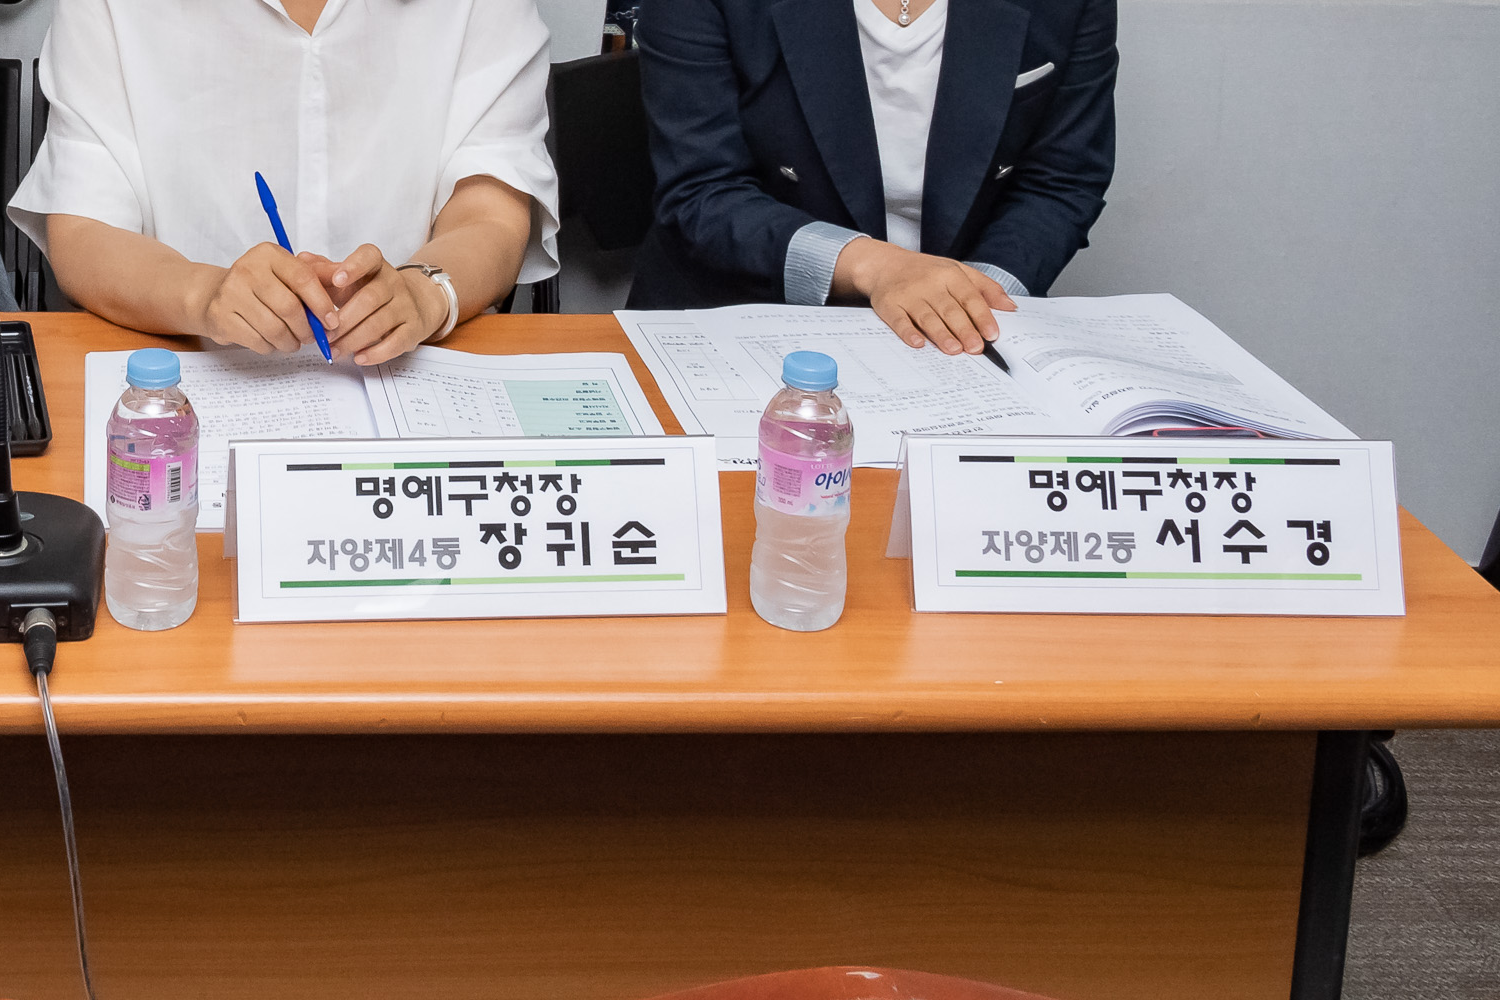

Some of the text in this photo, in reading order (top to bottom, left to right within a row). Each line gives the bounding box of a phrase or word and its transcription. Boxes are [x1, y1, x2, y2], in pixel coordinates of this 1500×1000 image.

[356, 472, 582, 519] 명예구청장
[1029, 469, 1257, 513] 명예구청장
[307, 537, 461, 573] 자양제4동
[981, 529, 1137, 564] 자양제2동
